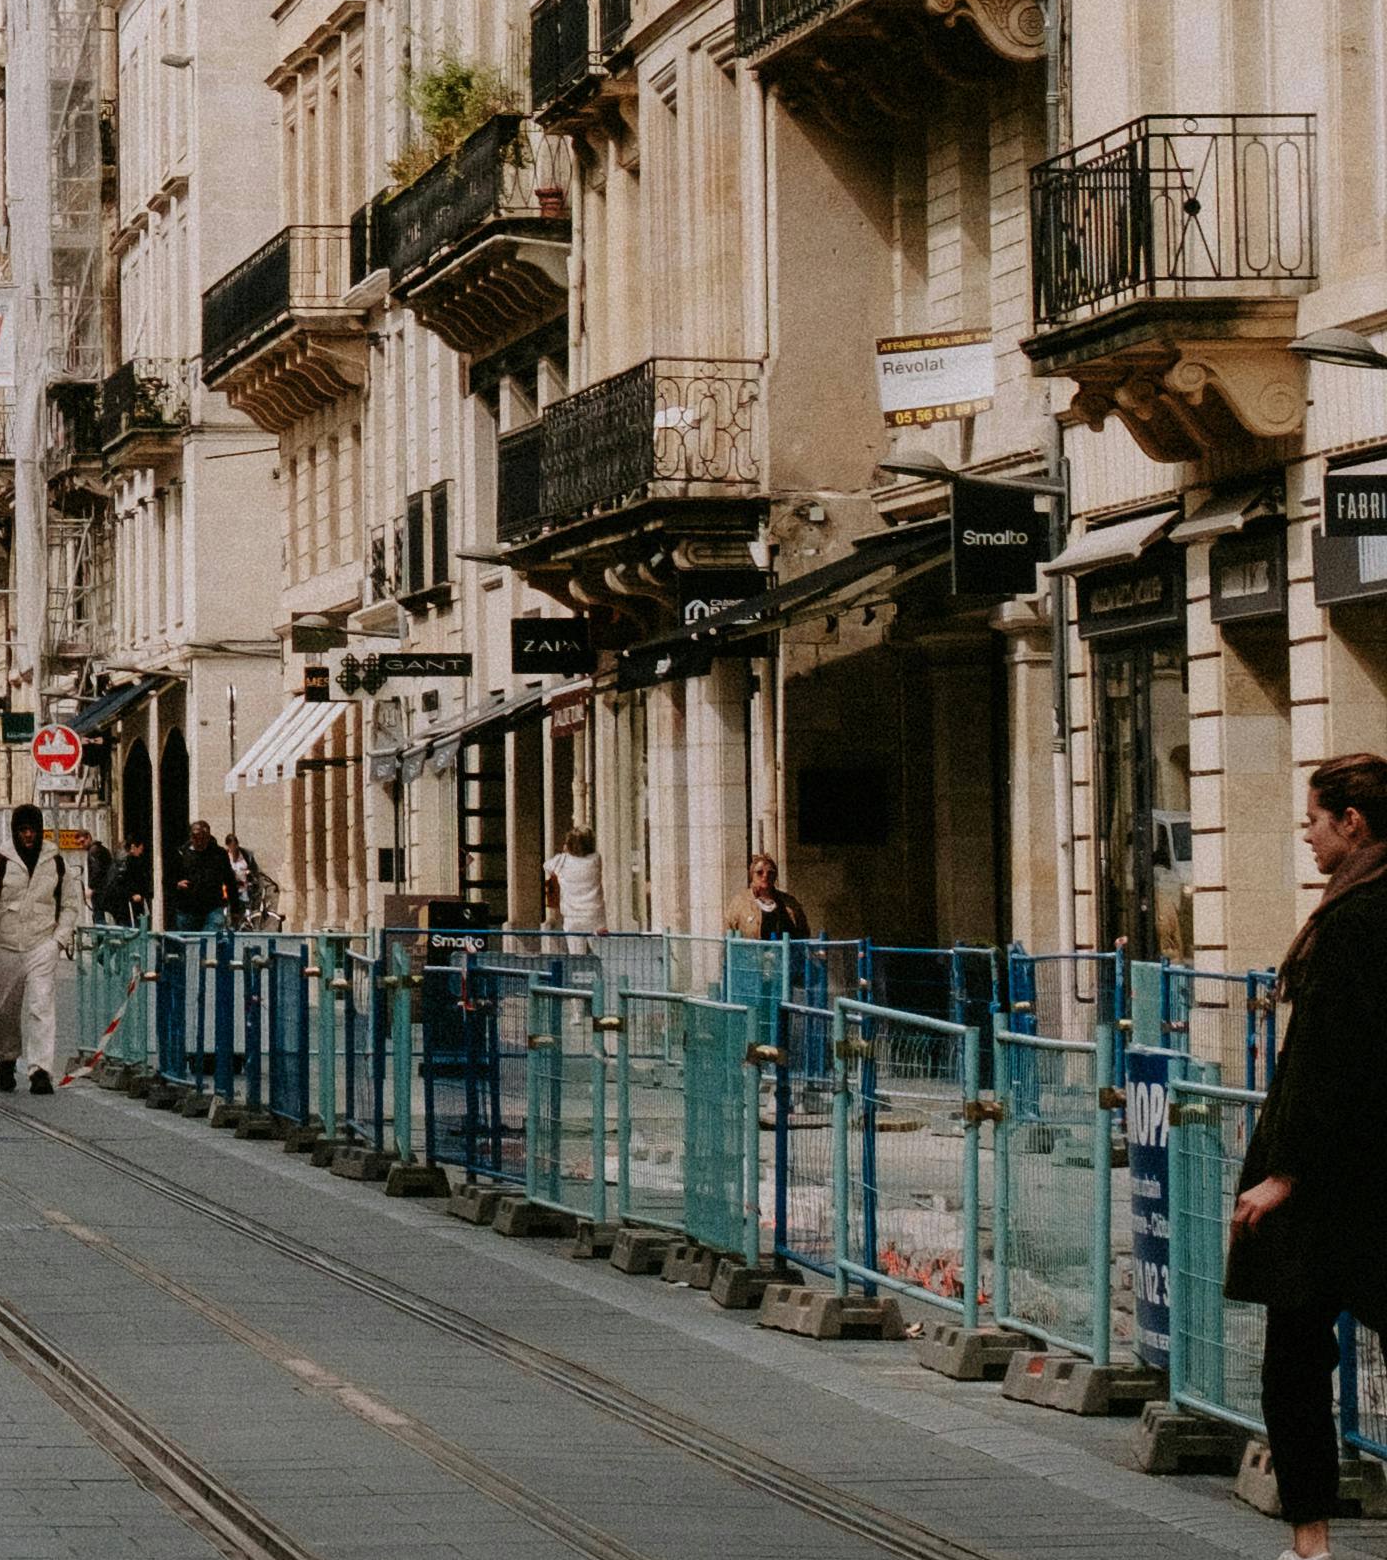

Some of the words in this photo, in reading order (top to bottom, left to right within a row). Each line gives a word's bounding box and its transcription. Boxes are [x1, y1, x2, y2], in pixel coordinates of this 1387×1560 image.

[883, 358, 945, 375] Révolat
[895, 412, 913, 425] 05
[1337, 492, 1386, 519] FABRI
[963, 529, 1028, 546] Smalto
[385, 660, 465, 670] GANT
